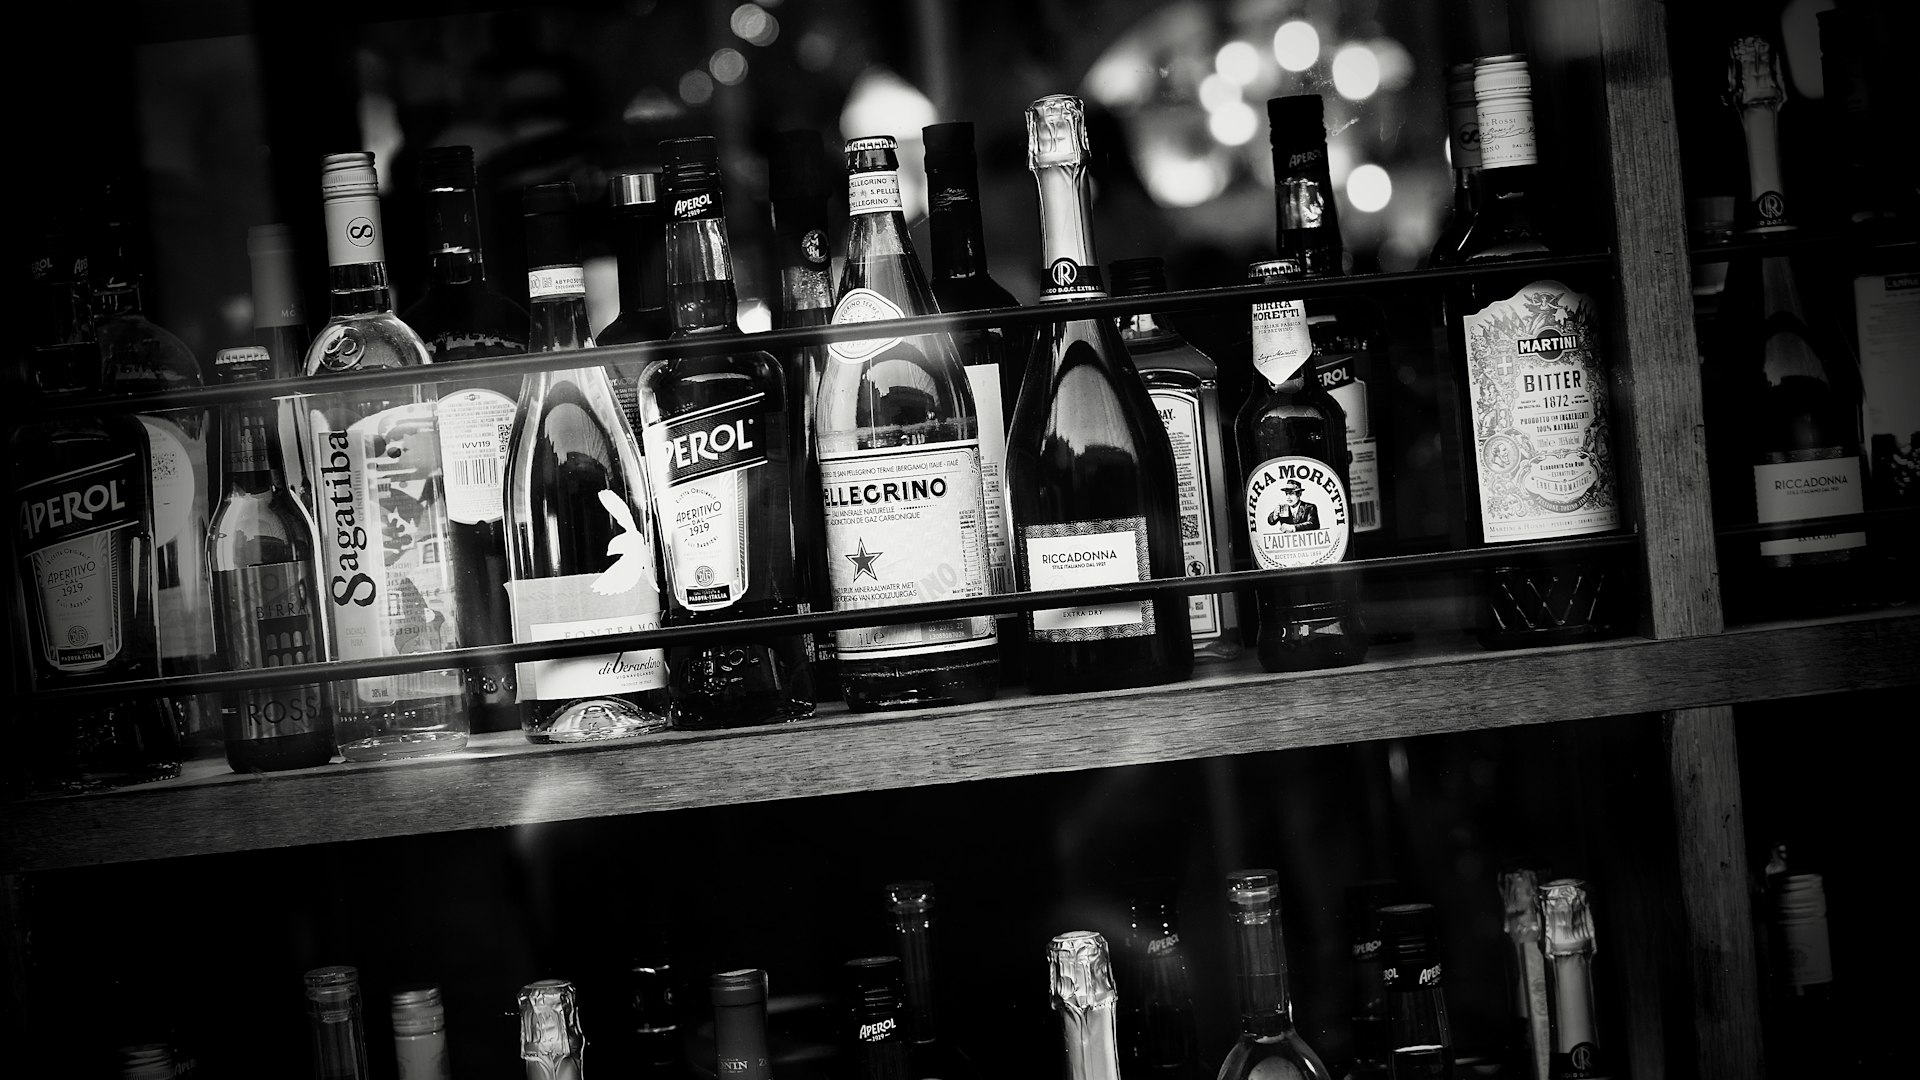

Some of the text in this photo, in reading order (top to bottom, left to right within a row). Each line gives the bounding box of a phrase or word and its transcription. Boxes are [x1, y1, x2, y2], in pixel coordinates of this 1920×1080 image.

[674, 193, 712, 216] APEROL
[1256, 300, 1292, 311] BIRRA
[1253, 308, 1300, 322] MORETTI
[1519, 335, 1577, 354] MARTINI
[1523, 370, 1582, 393] BITTER
[1543, 394, 1569, 409] 1872
[876, 465, 895, 474] TERME
[1775, 475, 1848, 490] RICCADONNA
[1249, 472, 1277, 533] BIRRA
[1278, 464, 1346, 526] MORETTI
[19, 479, 126, 543] APEROL
[676, 501, 722, 524] APERITIVO
[864, 506, 895, 515] NATURELLE
[864, 515, 878, 523] GAZ
[878, 512, 920, 522] CARBONIQUE
[321, 430, 377, 607] Sagatiba
[689, 522, 710, 537] 1919
[1264, 530, 1331, 550] L'AUTENTICA
[1042, 549, 1117, 565] RICCADONNA
[47, 560, 96, 585] APERITIVO
[62, 582, 84, 597] 1919
[901, 581, 915, 589] MET
[871, 589, 918, 600] KOOLZUURGAS
[1062, 610, 1086, 618] EXTRA
[859, 1017, 897, 1039] APEROL
